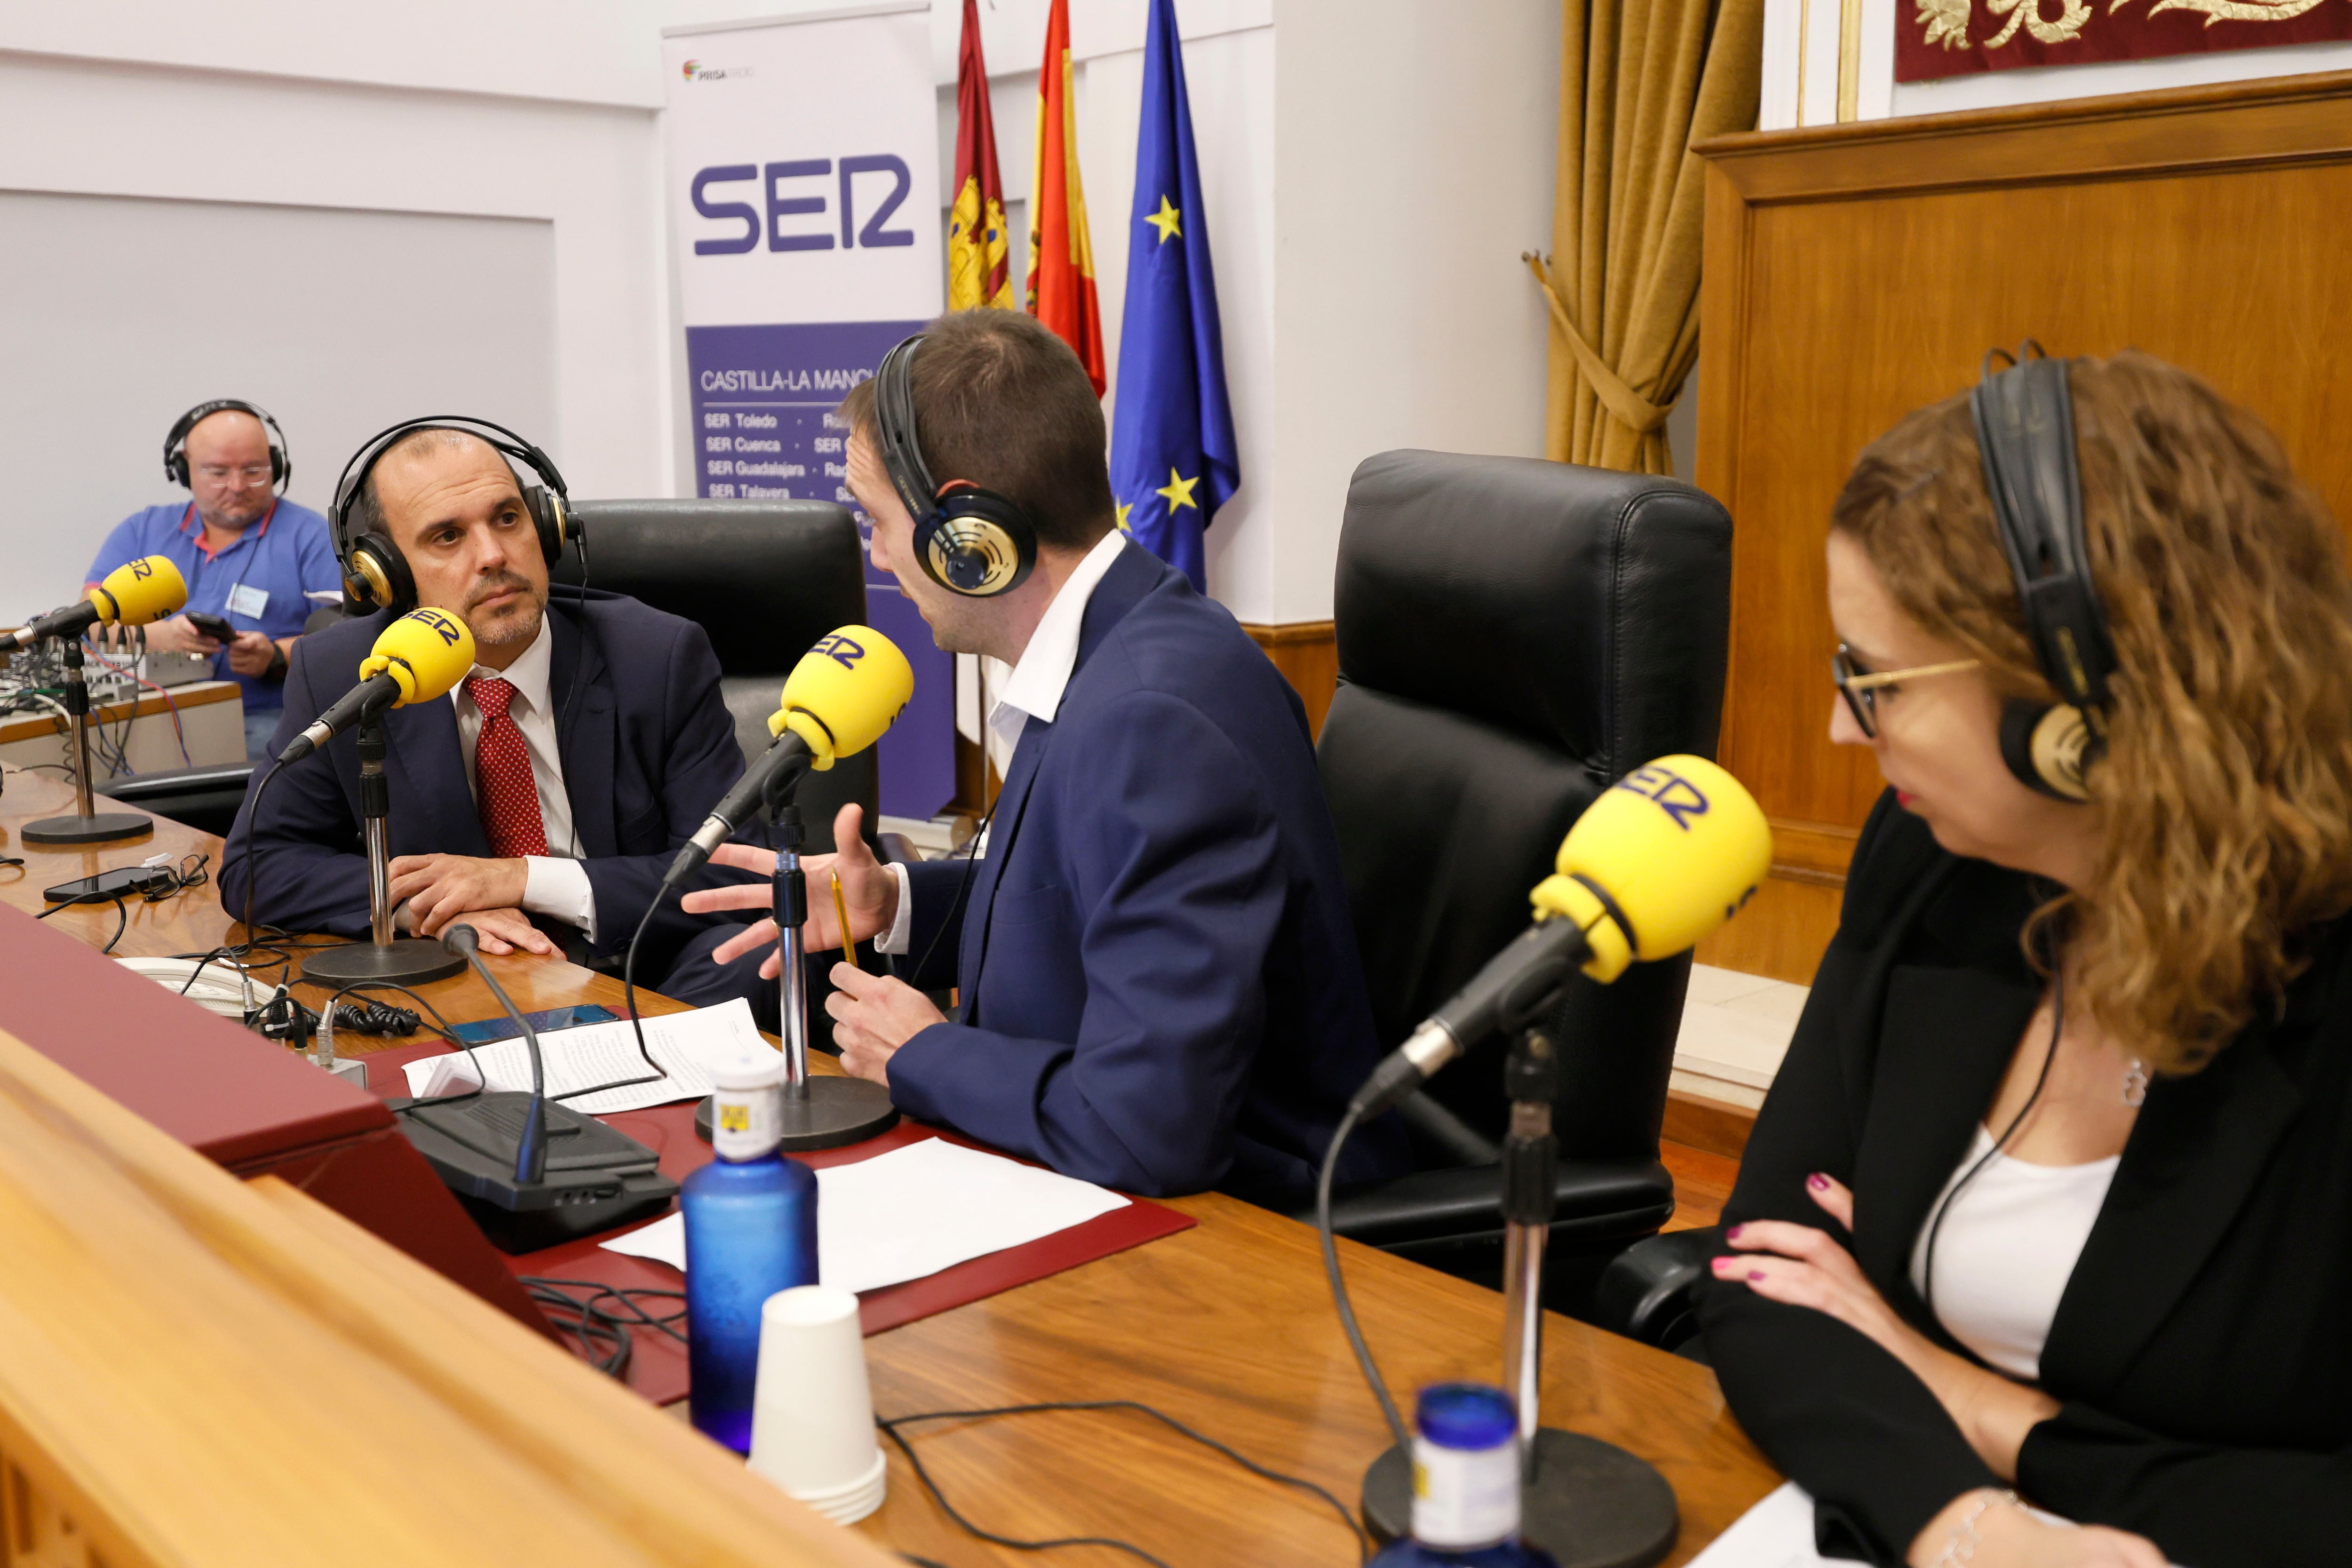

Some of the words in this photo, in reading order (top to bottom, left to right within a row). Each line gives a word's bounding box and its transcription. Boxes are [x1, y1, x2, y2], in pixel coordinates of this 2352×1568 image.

[691, 154, 914, 255] SER
[701, 369, 811, 391] CASTILLA-LA
[704, 413, 730, 429] SER
[735, 413, 778, 429] Toledo
[706, 437, 732, 453] SER
[735, 437, 781, 453] Cuenca
[814, 437, 841, 453] SER
[707, 460, 733, 476] SER
[735, 460, 806, 479] Guadalajara
[709, 483, 735, 499] SER
[739, 484, 790, 499] Talavera
[807, 635, 865, 670] ER
[1617, 766, 1708, 830] ER
